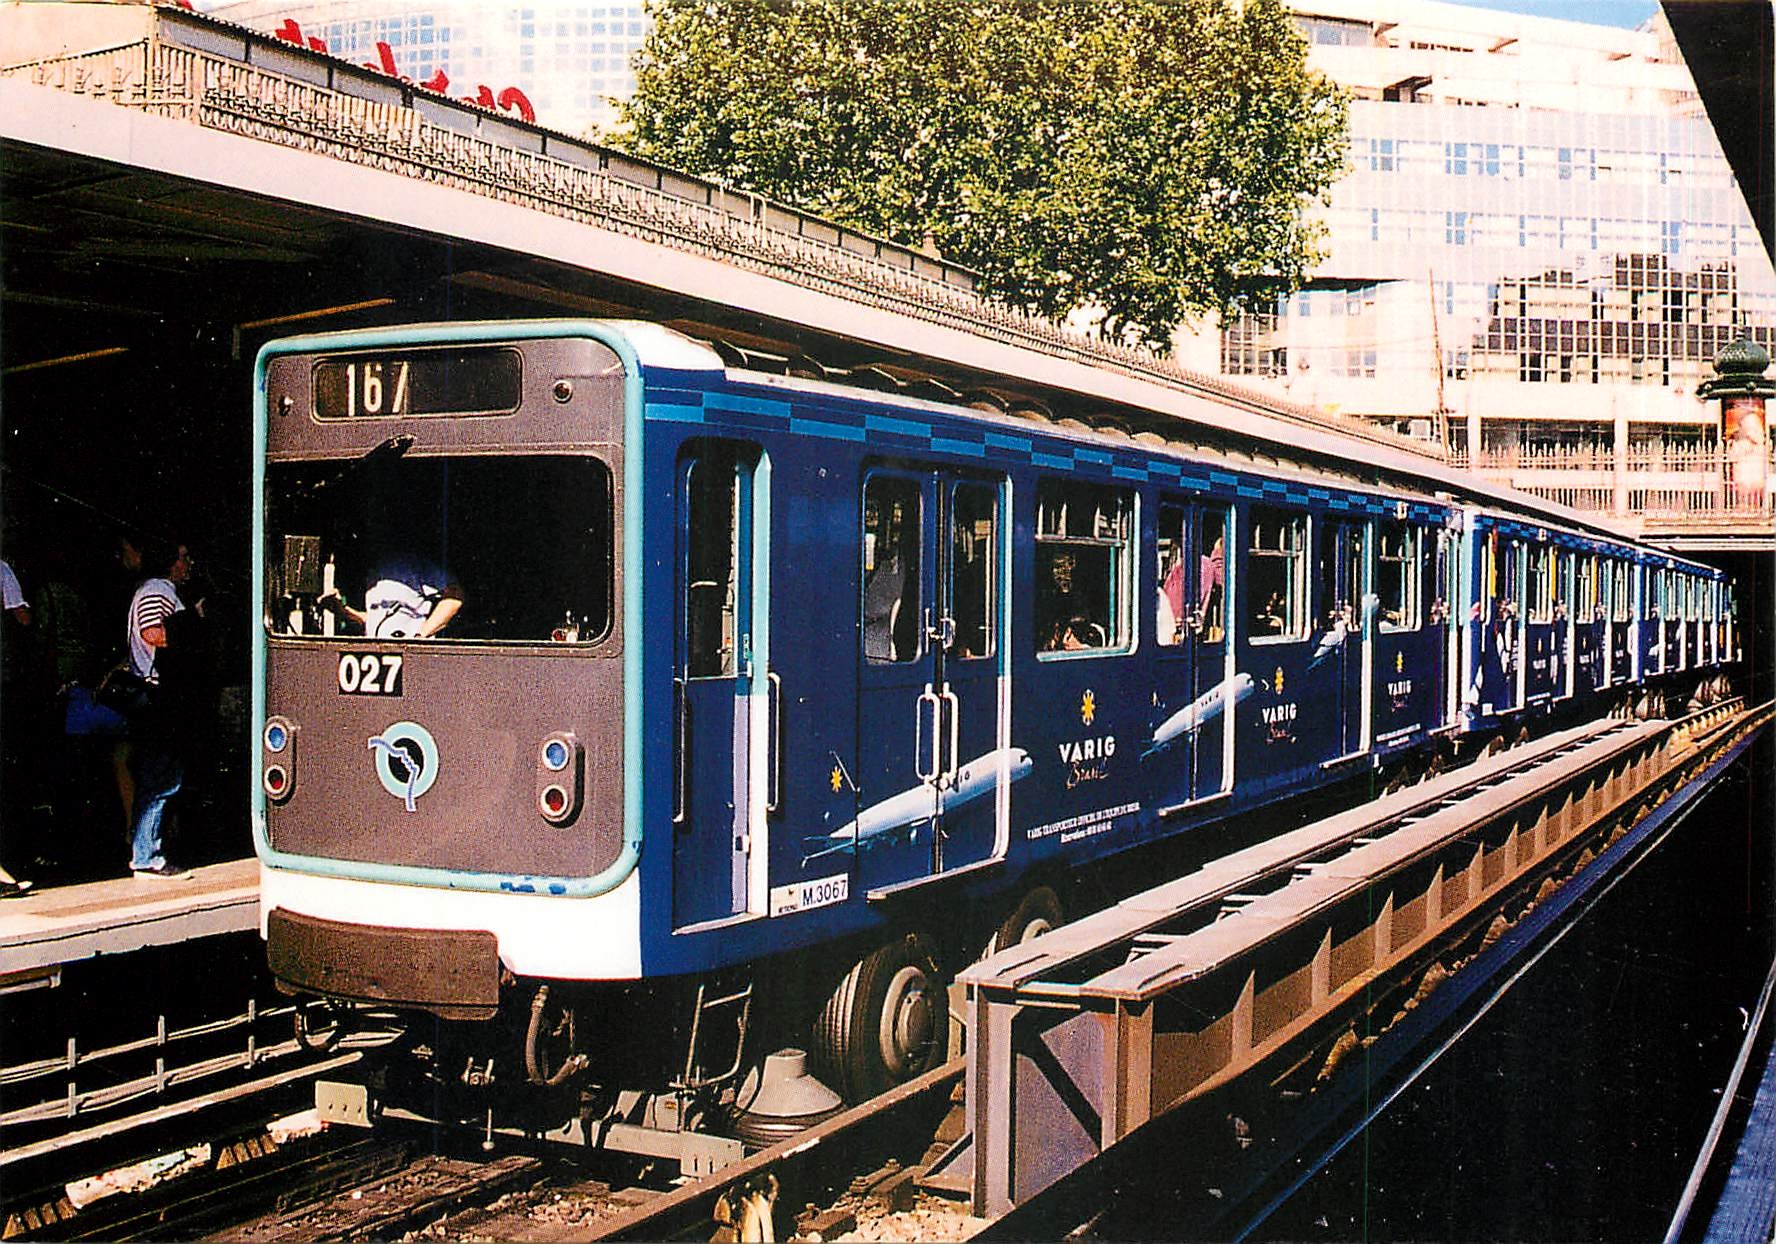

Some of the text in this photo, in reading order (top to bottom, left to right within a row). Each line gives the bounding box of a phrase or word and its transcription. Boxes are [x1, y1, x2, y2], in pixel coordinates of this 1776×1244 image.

[339, 654, 402, 693] 027
[1262, 703, 1297, 723] VARIG
[1059, 735, 1115, 763] VARIG
[803, 879, 846, 906] M.3067
